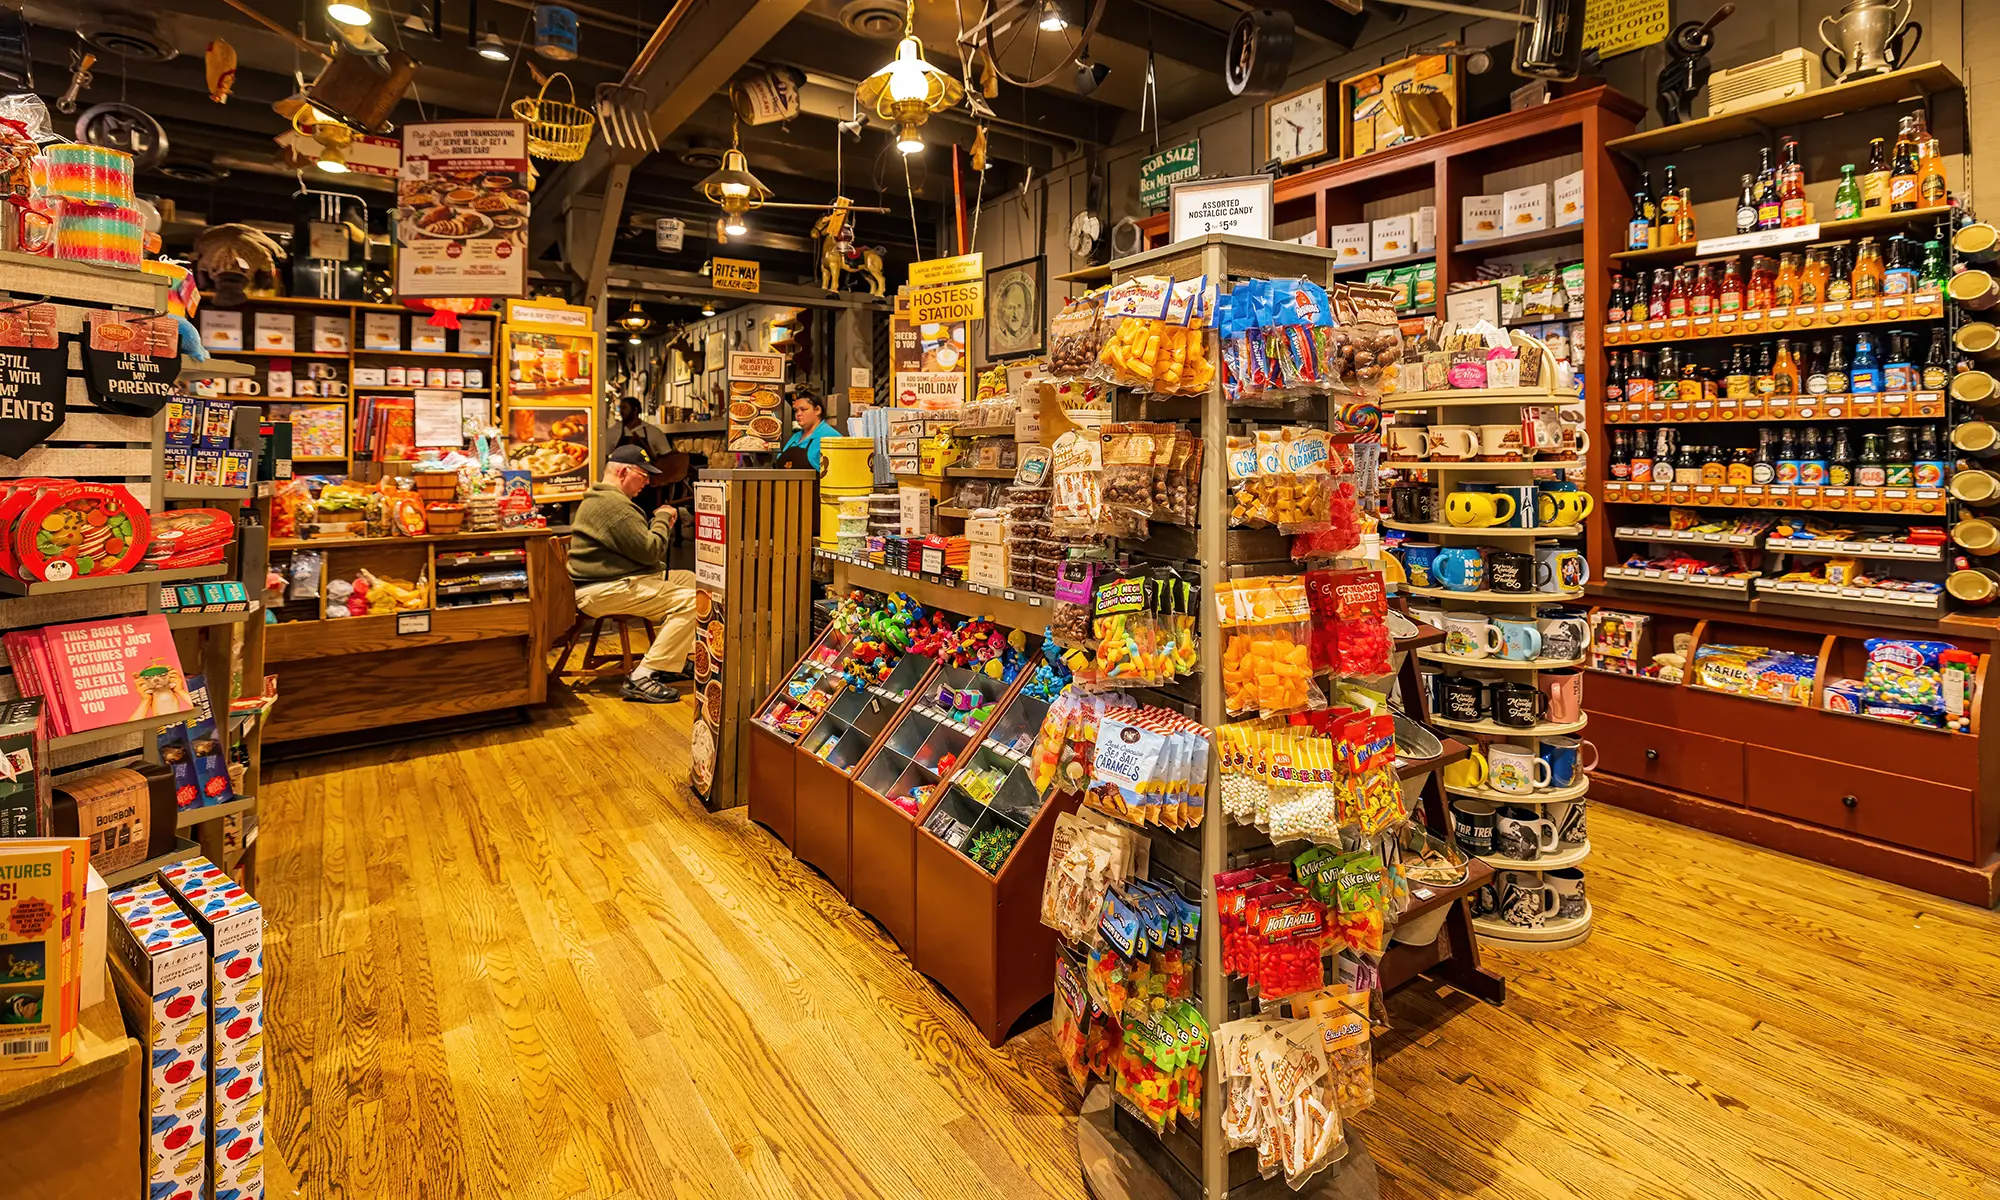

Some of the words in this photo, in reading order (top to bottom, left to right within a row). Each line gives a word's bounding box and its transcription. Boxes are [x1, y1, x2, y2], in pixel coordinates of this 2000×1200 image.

[1646, 23, 1666, 35] CO
[1141, 155, 1165, 177] FOR
[1166, 147, 1196, 164] SALE
[1140, 178, 1156, 192] BEN
[1202, 198, 1240, 210] ASSORTED
[1509, 199, 1540, 211] PANCAKE
[1188, 208, 1228, 219] NOSTALGIC
[1229, 206, 1254, 216] CANDY
[1470, 209, 1501, 217] PANCAKE
[1204, 222, 1211, 232] 3
[1378, 229, 1405, 238] PANCAKE
[715, 263, 758, 280] RITE-WAY
[946, 262, 956, 270] AND
[715, 278, 740, 289] MILKER
[913, 287, 979, 306] HOSTESS
[918, 303, 974, 322] STATION
[902, 340, 916, 348] YOU
[124, 352, 128, 361] I
[129, 353, 152, 363] STILL
[741, 357, 773, 366] HOMESTYLE
[117, 360, 136, 371] LIVE
[137, 362, 160, 373] WITH
[739, 363, 761, 371] HOLIDAY
[762, 364, 775, 372] PIES
[8, 369, 41, 386] WITH
[132, 371, 147, 381] MY
[109, 378, 170, 396] PARENTS
[917, 382, 958, 394] HOLIDAY
[209, 401, 230, 409] MULTI
[1055, 442, 1073, 456] COW
[1293, 438, 1323, 454] Vanilla
[1054, 453, 1073, 465] TALES
[1288, 447, 1328, 472] CARAMELS
[58, 486, 82, 499] DOG
[83, 485, 115, 497] TREATS
[504, 510, 538, 524] DOTS
[1101, 586, 1118, 599] SOUR
[1122, 583, 1140, 594] NEON
[1335, 582, 1380, 596] CINNAMON
[1119, 594, 1143, 605] WORMS
[1343, 591, 1378, 605] BEARS
[61, 630, 89, 642] THIS
[91, 626, 121, 639] BOOK
[123, 623, 135, 635] IS
[64, 637, 122, 654] LITERALLY
[125, 633, 152, 646] JUST
[68, 649, 123, 666] PICTURES
[124, 646, 138, 658] OF
[1875, 647, 1919, 659] DUBBLE
[1874, 655, 1918, 667] BUBBLE
[72, 661, 125, 678] ANIMALS
[75, 674, 127, 690] SILENTLY
[78, 686, 129, 703] JUDGING
[81, 702, 106, 715] YOU
[1104, 746, 1119, 759] SEA
[1119, 751, 1139, 765] SALT
[1095, 754, 1141, 782] CARAMELS
[96, 805, 136, 827] BOURBON
[1473, 826, 1494, 838] TREK
[1341, 871, 1364, 890] Mike
[1265, 916, 1284, 935] HOT
[1279, 1066, 1295, 1095] TALES
